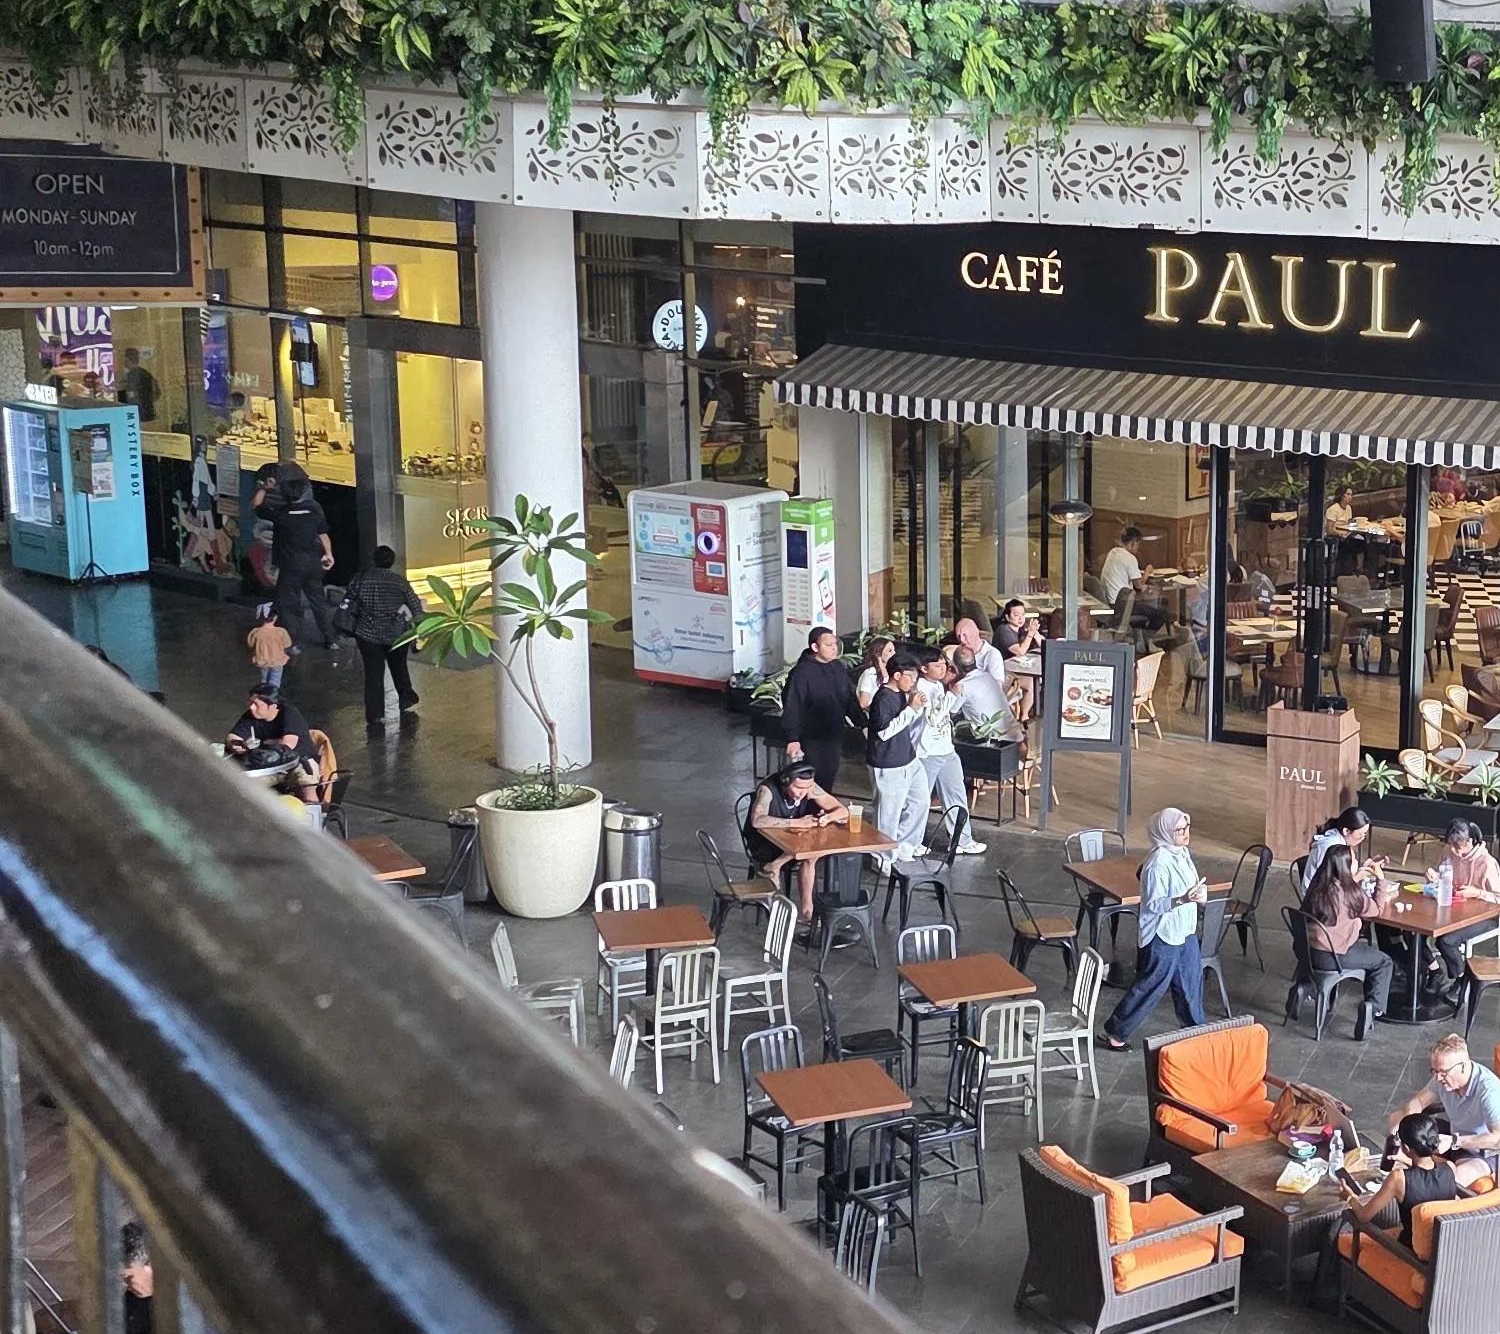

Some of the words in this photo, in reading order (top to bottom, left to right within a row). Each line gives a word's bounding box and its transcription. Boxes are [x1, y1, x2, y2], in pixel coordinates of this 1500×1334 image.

[35, 174, 105, 195] OPEN
[960, 249, 1064, 295] CAFÉ
[1144, 247, 1423, 340] PAUL
[126, 411, 139, 468] MYSTERY
[130, 472, 141, 497] BOX
[1074, 651, 1106, 662] PAUL
[1279, 766, 1326, 785] PAUL
